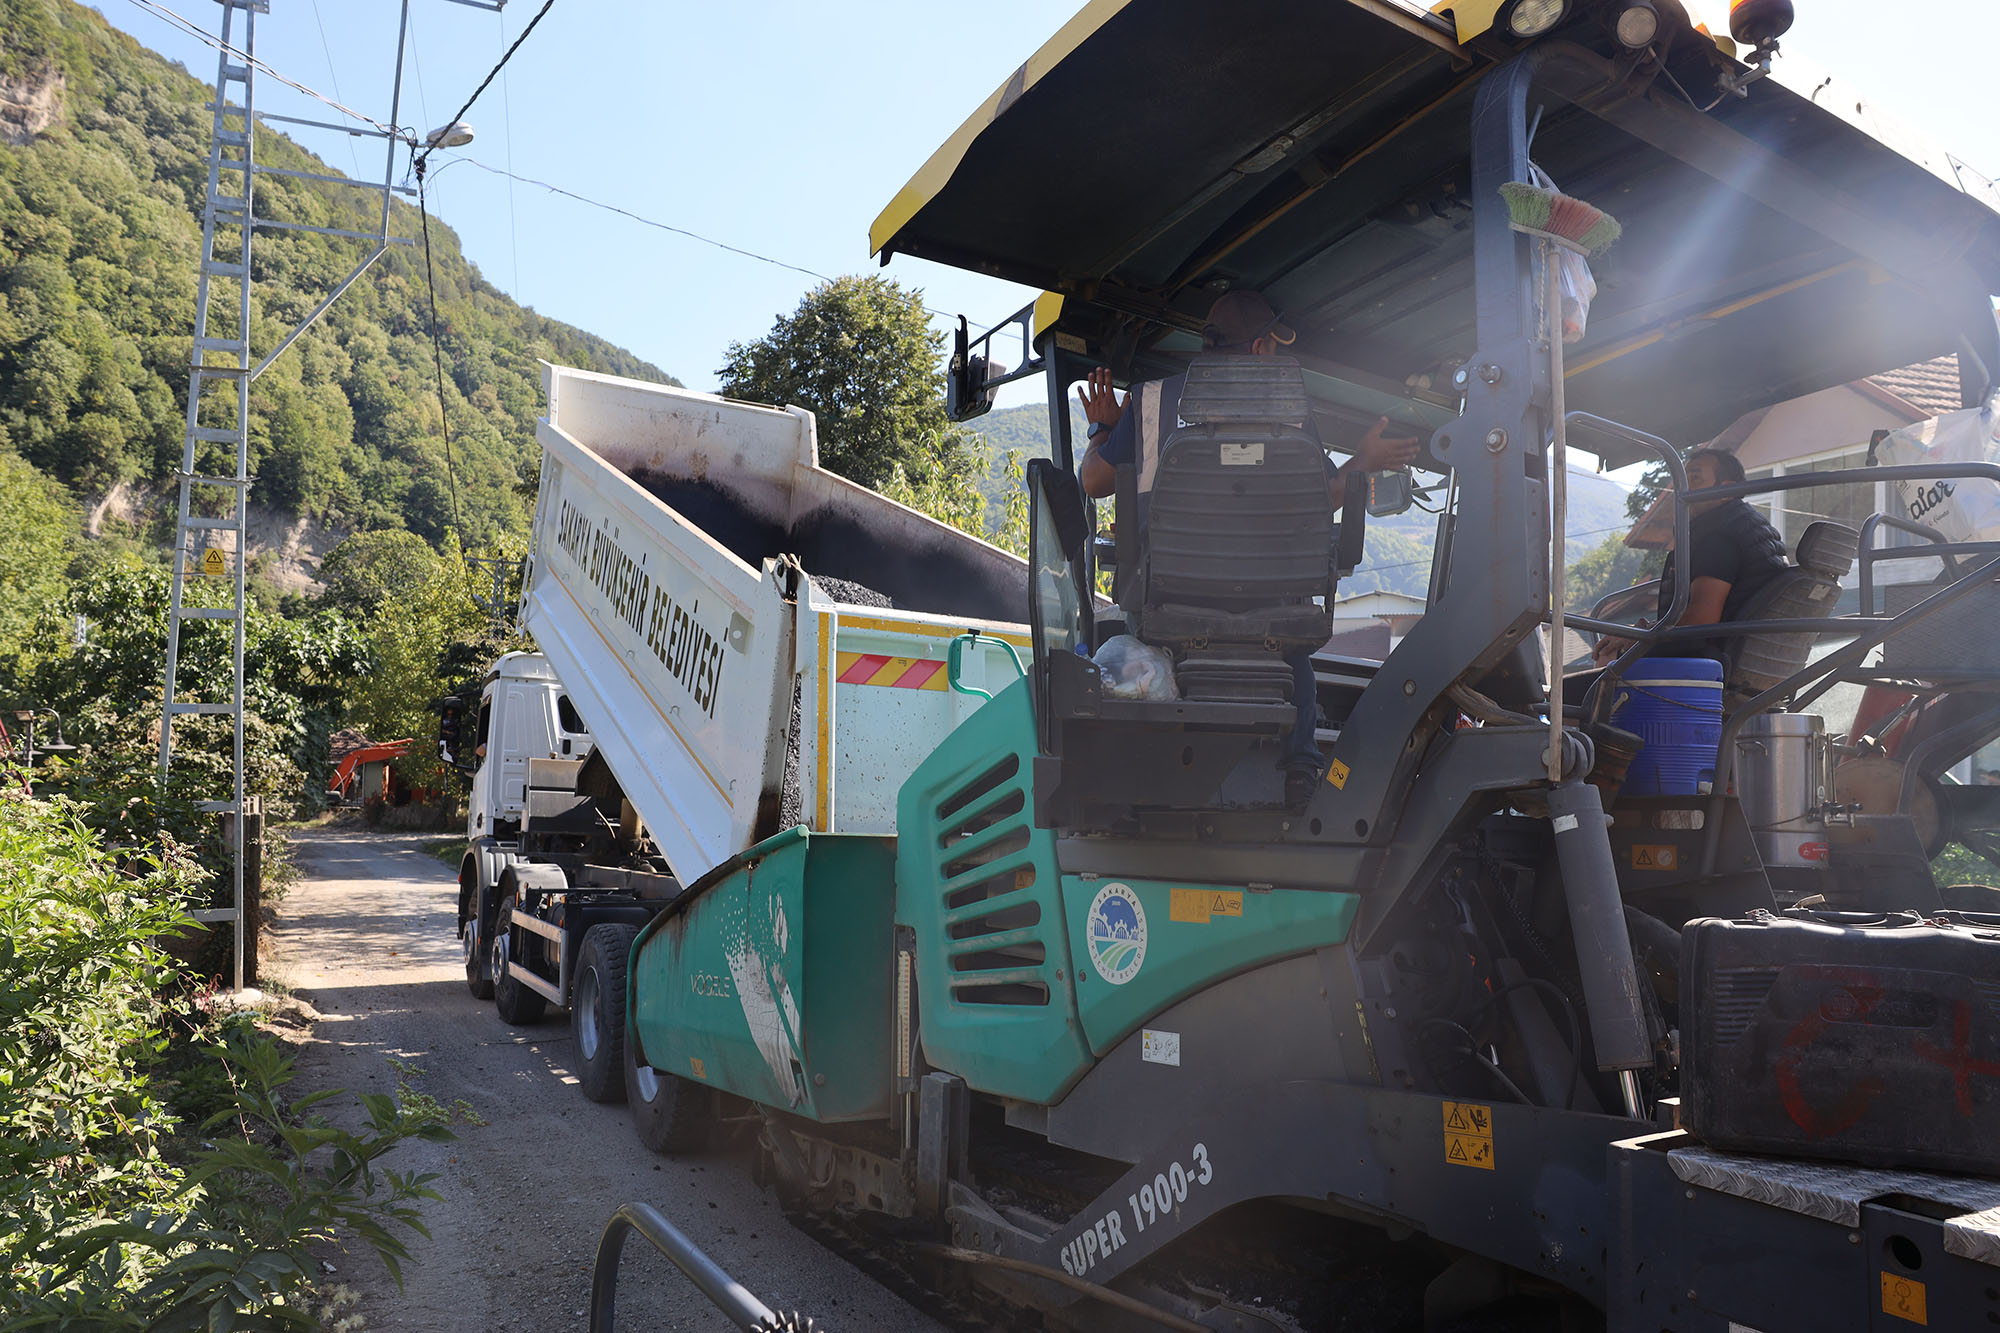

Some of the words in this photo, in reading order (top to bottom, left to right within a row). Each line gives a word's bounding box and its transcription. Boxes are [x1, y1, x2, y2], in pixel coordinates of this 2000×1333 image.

[558, 499, 592, 573] SAKARYA
[589, 517, 650, 637] BÜYÜKŞEHİR
[647, 584, 729, 720] BELEDİYESİ
[1098, 887, 1137, 907] SAKARYA
[690, 969, 731, 998] VÖGELE
[1060, 1210, 1127, 1277] SUPER
[1128, 1143, 1213, 1232] 1900-3
